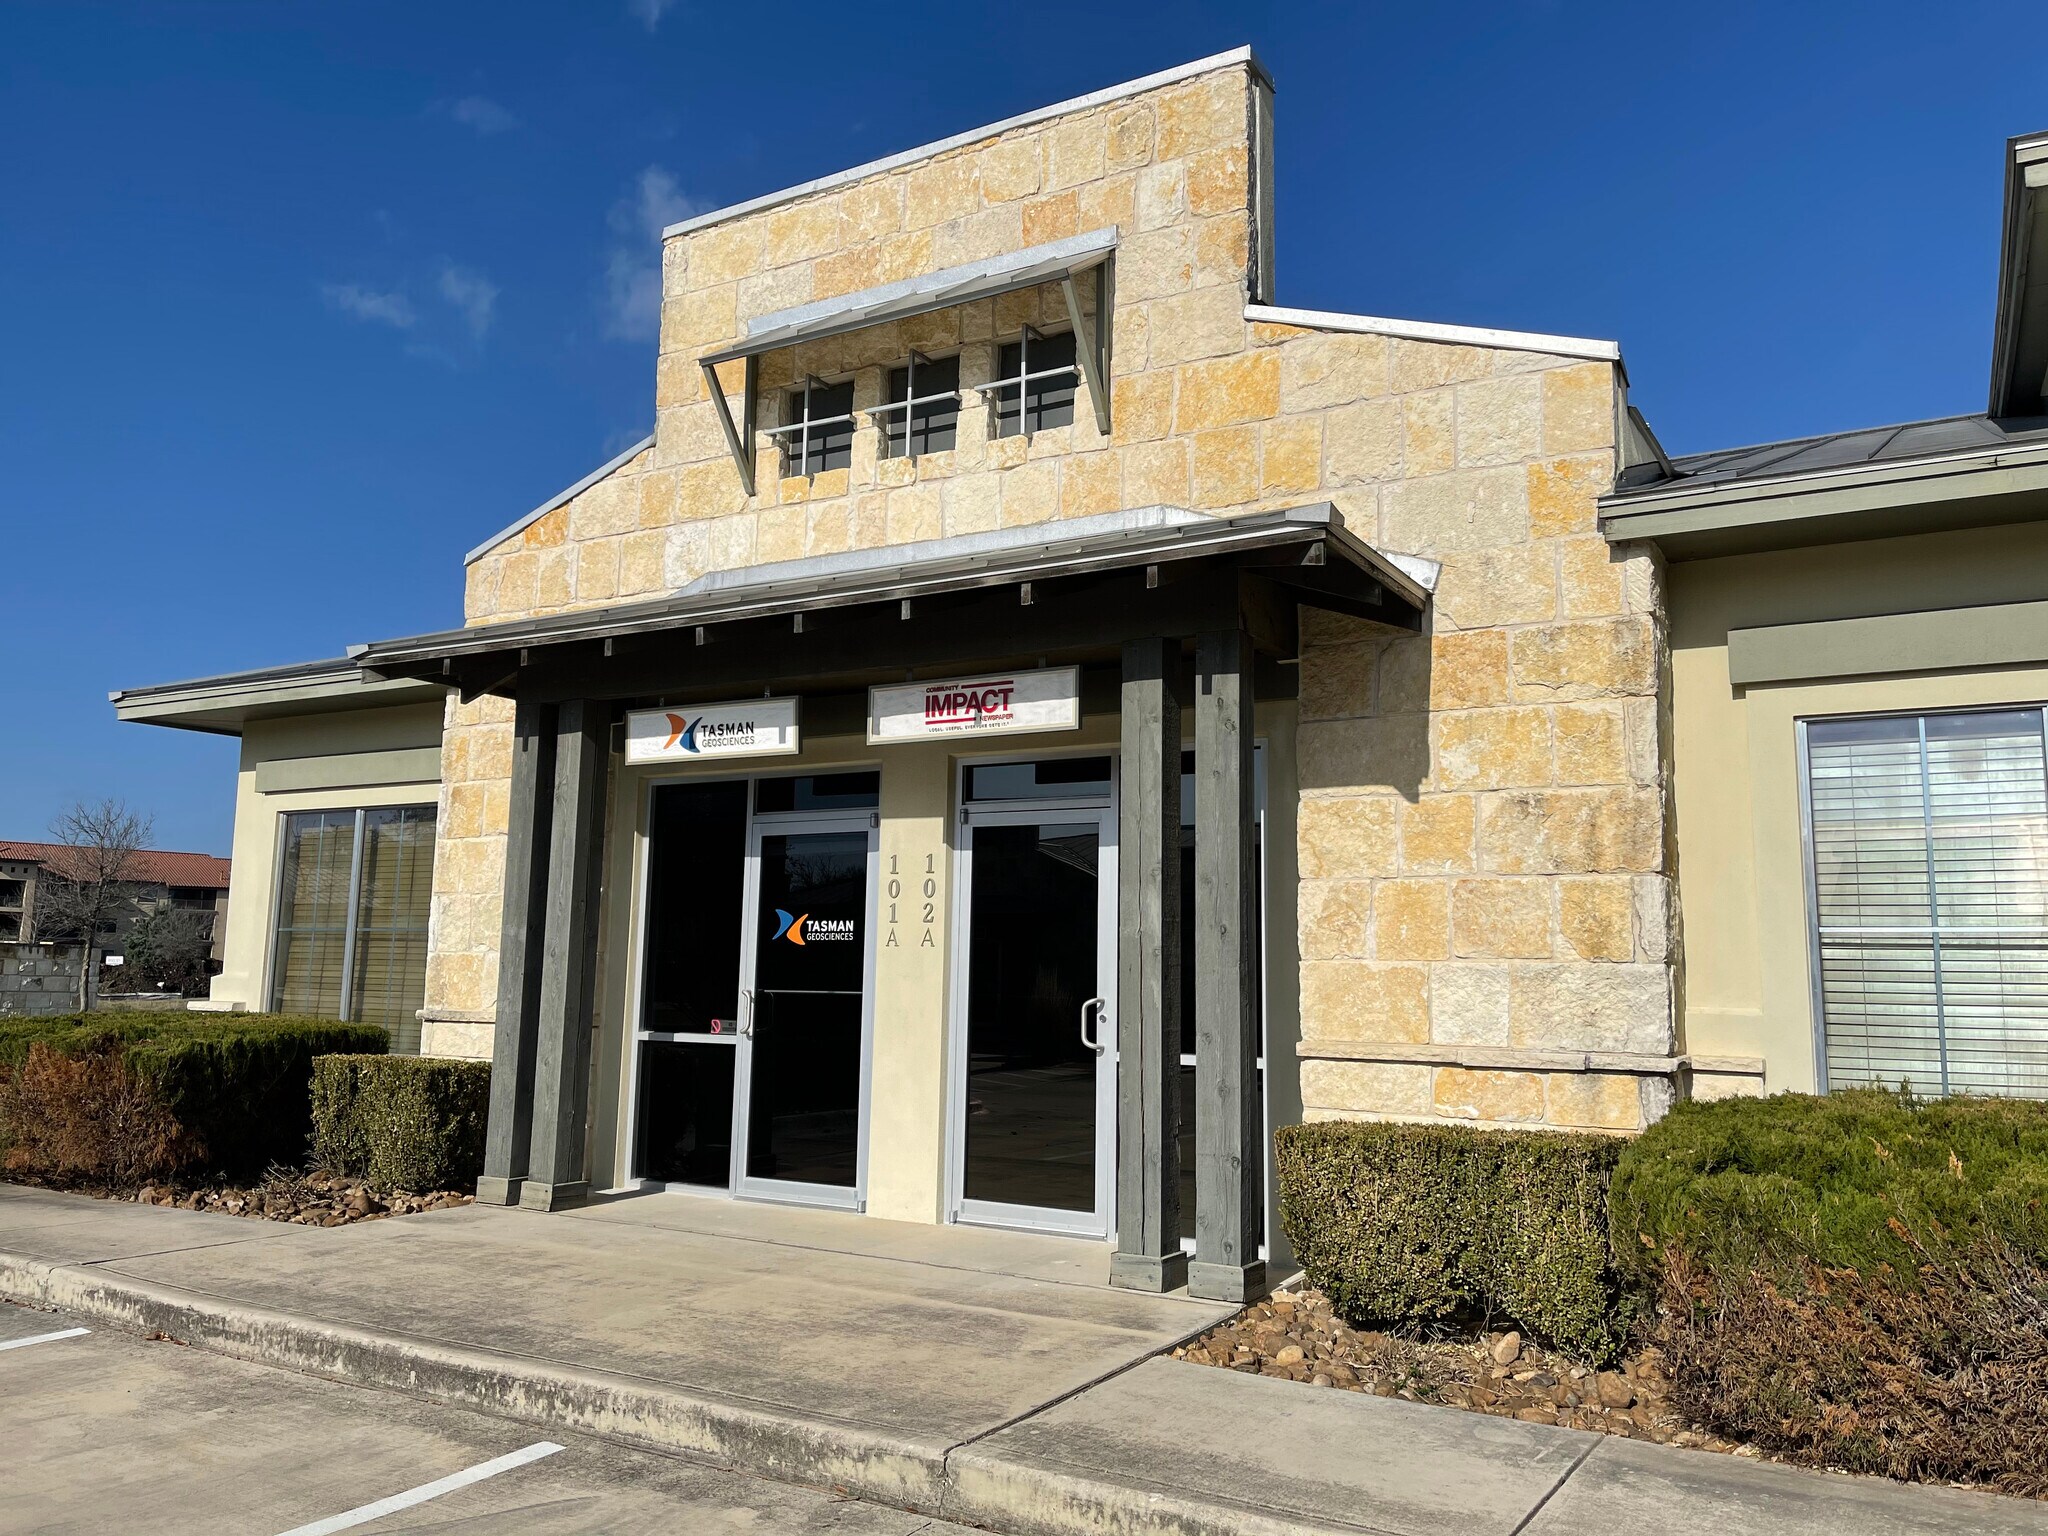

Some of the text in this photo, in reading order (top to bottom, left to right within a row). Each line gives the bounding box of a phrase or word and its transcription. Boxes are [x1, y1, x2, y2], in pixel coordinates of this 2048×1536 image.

[926, 685, 960, 693] COMMUNITY
[925, 688, 1014, 718] IMPACT
[979, 713, 1014, 722] NEWSPAPER
[701, 721, 755, 737] TASMAN
[702, 735, 755, 748] GEOSCIENCES
[806, 919, 854, 932] TASMAN
[806, 932, 854, 941] GEOSCIENCES
